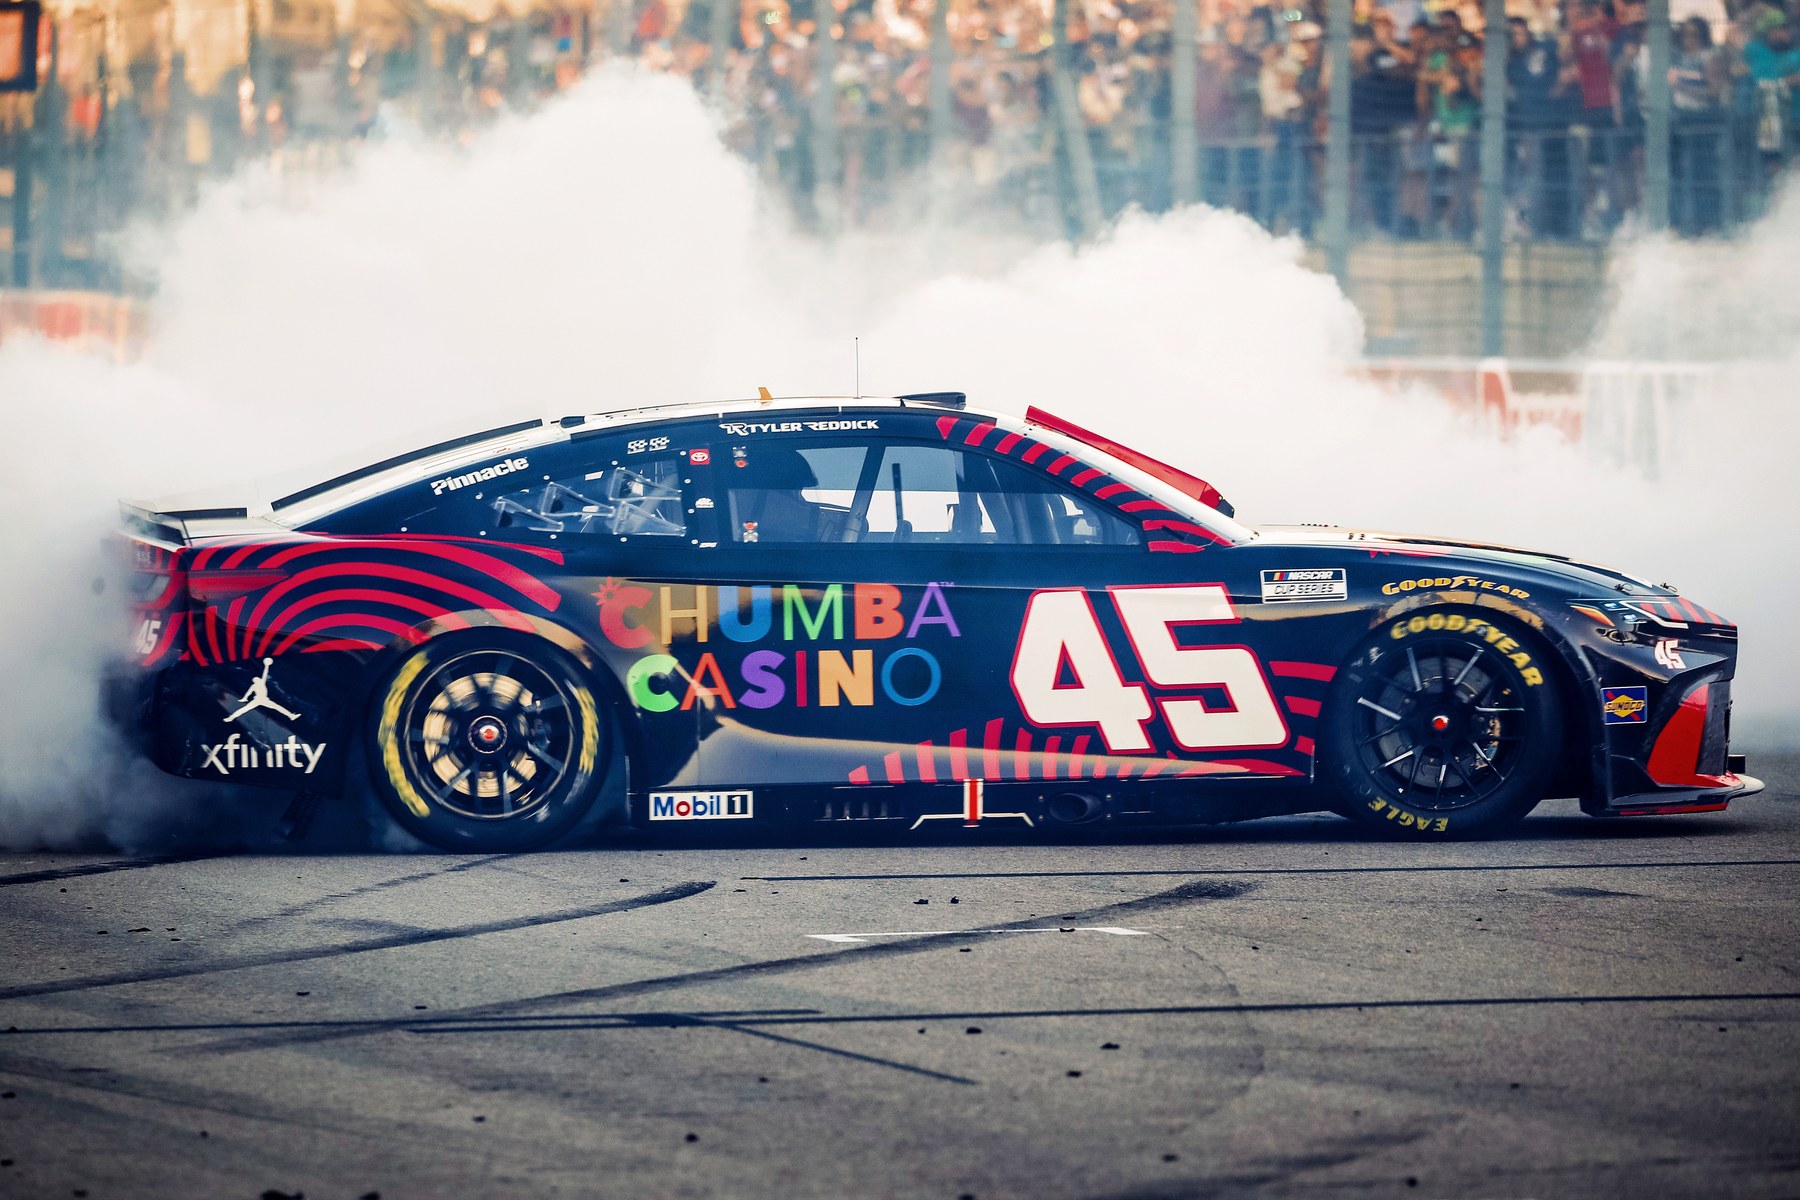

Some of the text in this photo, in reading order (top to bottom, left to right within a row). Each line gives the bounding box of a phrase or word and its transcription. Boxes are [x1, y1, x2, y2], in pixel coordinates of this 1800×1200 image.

[748, 421, 803, 433] TYLER
[803, 420, 879, 431] REDDICK
[430, 457, 529, 496] Pinnacle
[1274, 584, 1335, 594] CUP SERIES
[1288, 571, 1333, 580] NASCAR
[1381, 575, 1531, 600] GOODYEAR
[598, 581, 962, 649] CHUMBA
[135, 620, 162, 654] 45
[1390, 613, 1544, 687] GOODYEAR
[1008, 582, 1290, 754] 45
[1654, 638, 1687, 670] 45
[626, 647, 942, 713] CASINO
[1605, 701, 1643, 711] SUNOCO
[653, 795, 743, 817] Mobil 1
[1368, 796, 1449, 832] EAGLE
